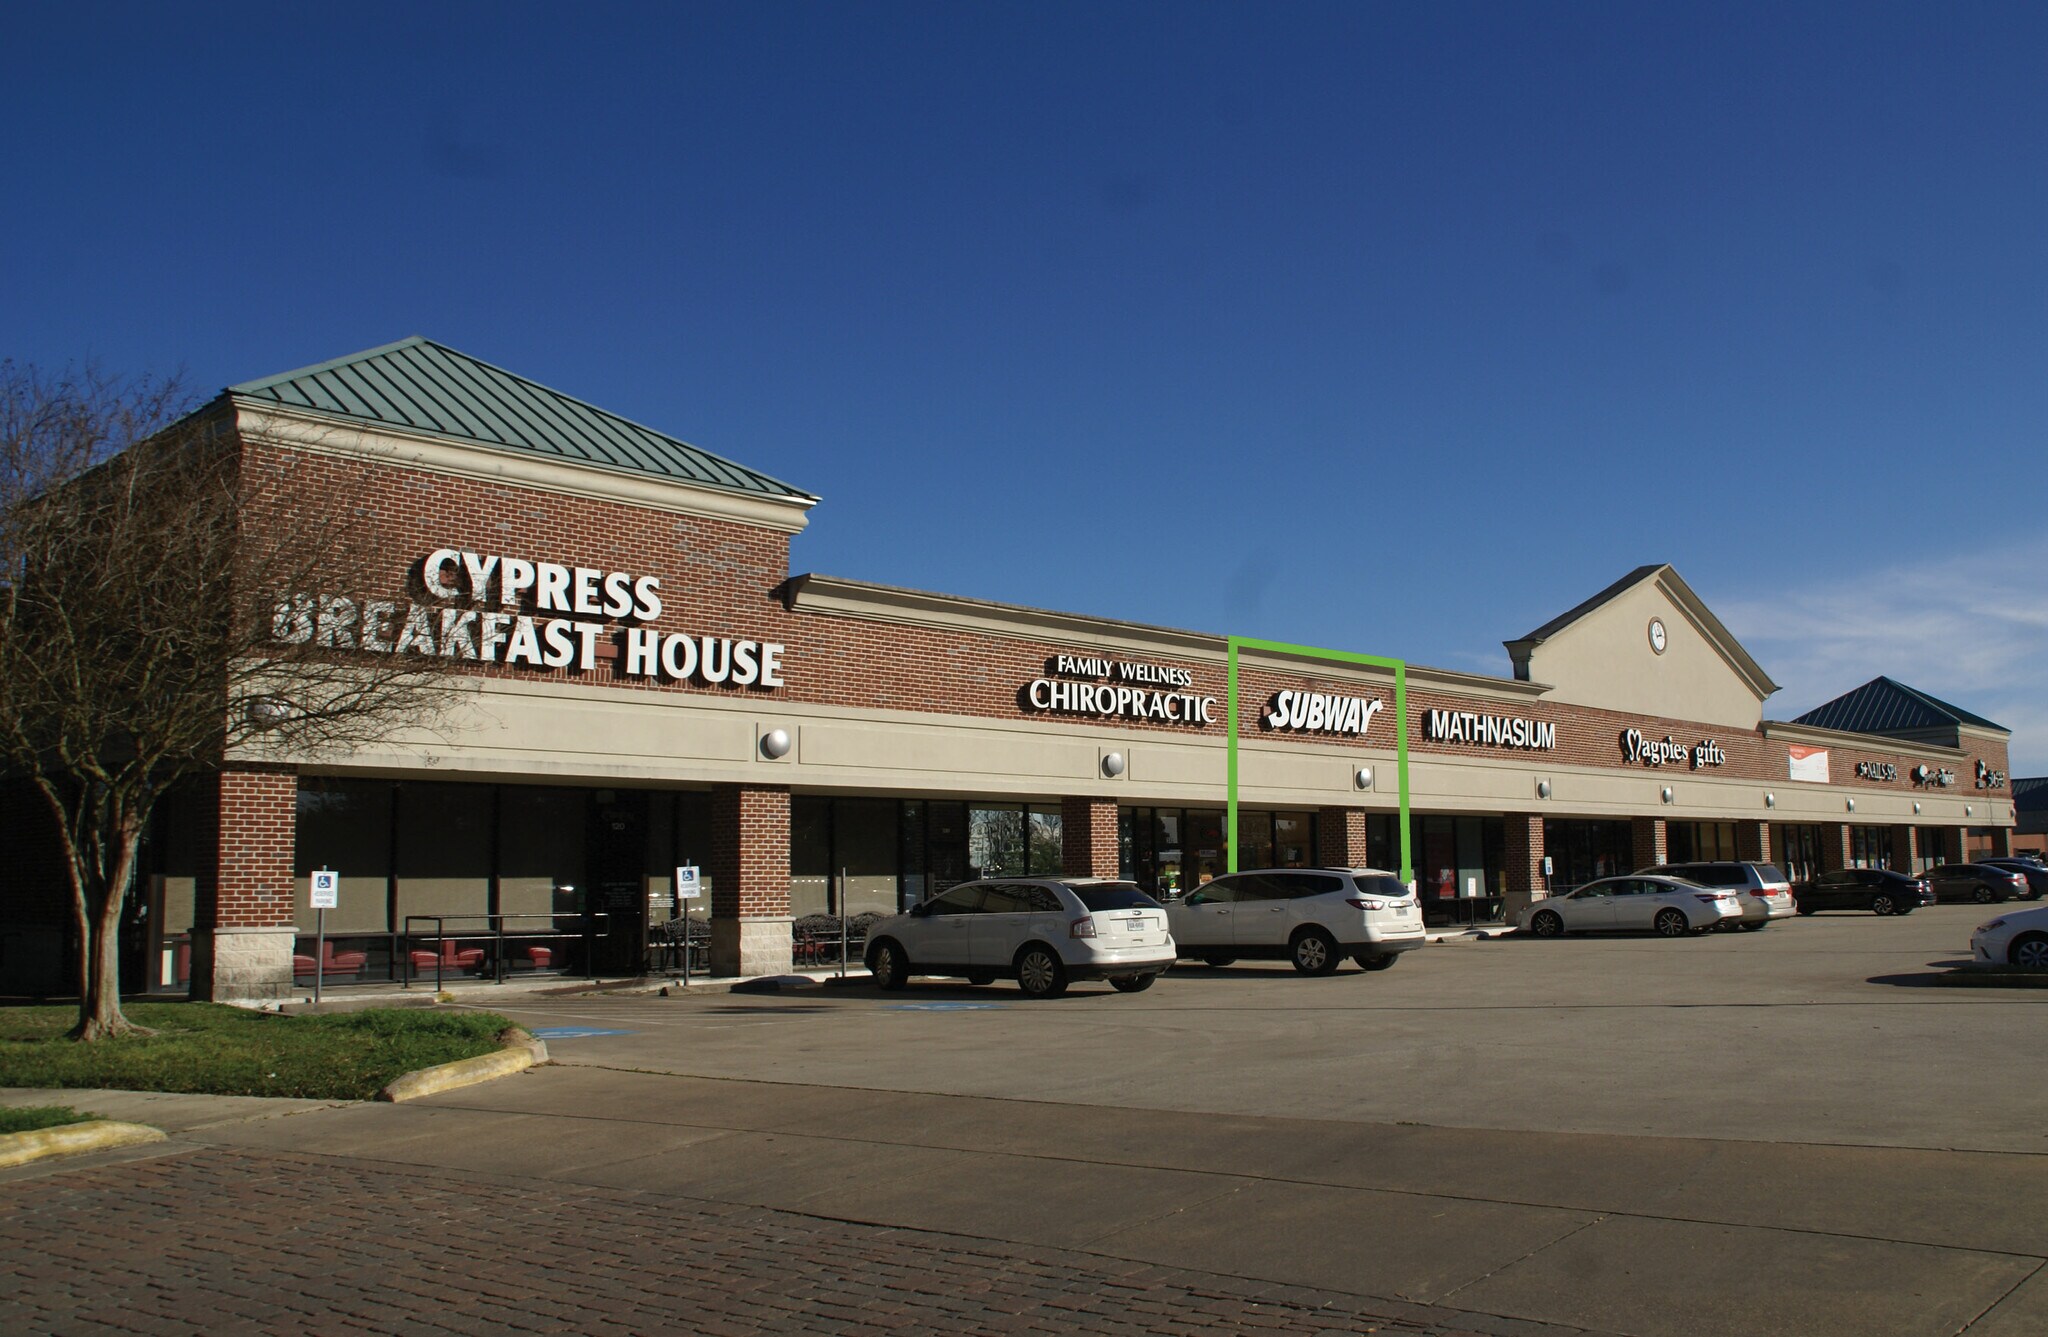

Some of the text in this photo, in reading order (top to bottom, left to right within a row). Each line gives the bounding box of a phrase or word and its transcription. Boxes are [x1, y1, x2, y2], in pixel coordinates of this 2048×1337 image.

[424, 549, 662, 621] CYPRESS
[272, 593, 785, 687] BREAKFAST HOUSE
[1058, 655, 1192, 686] FAMILY WELLNESS
[1029, 679, 1217, 723] CHIROPRACTIC
[1268, 690, 1384, 733] SUBWAY
[1431, 709, 1556, 749] MATHNASIUM
[1627, 728, 1726, 768] Magpies gifts
